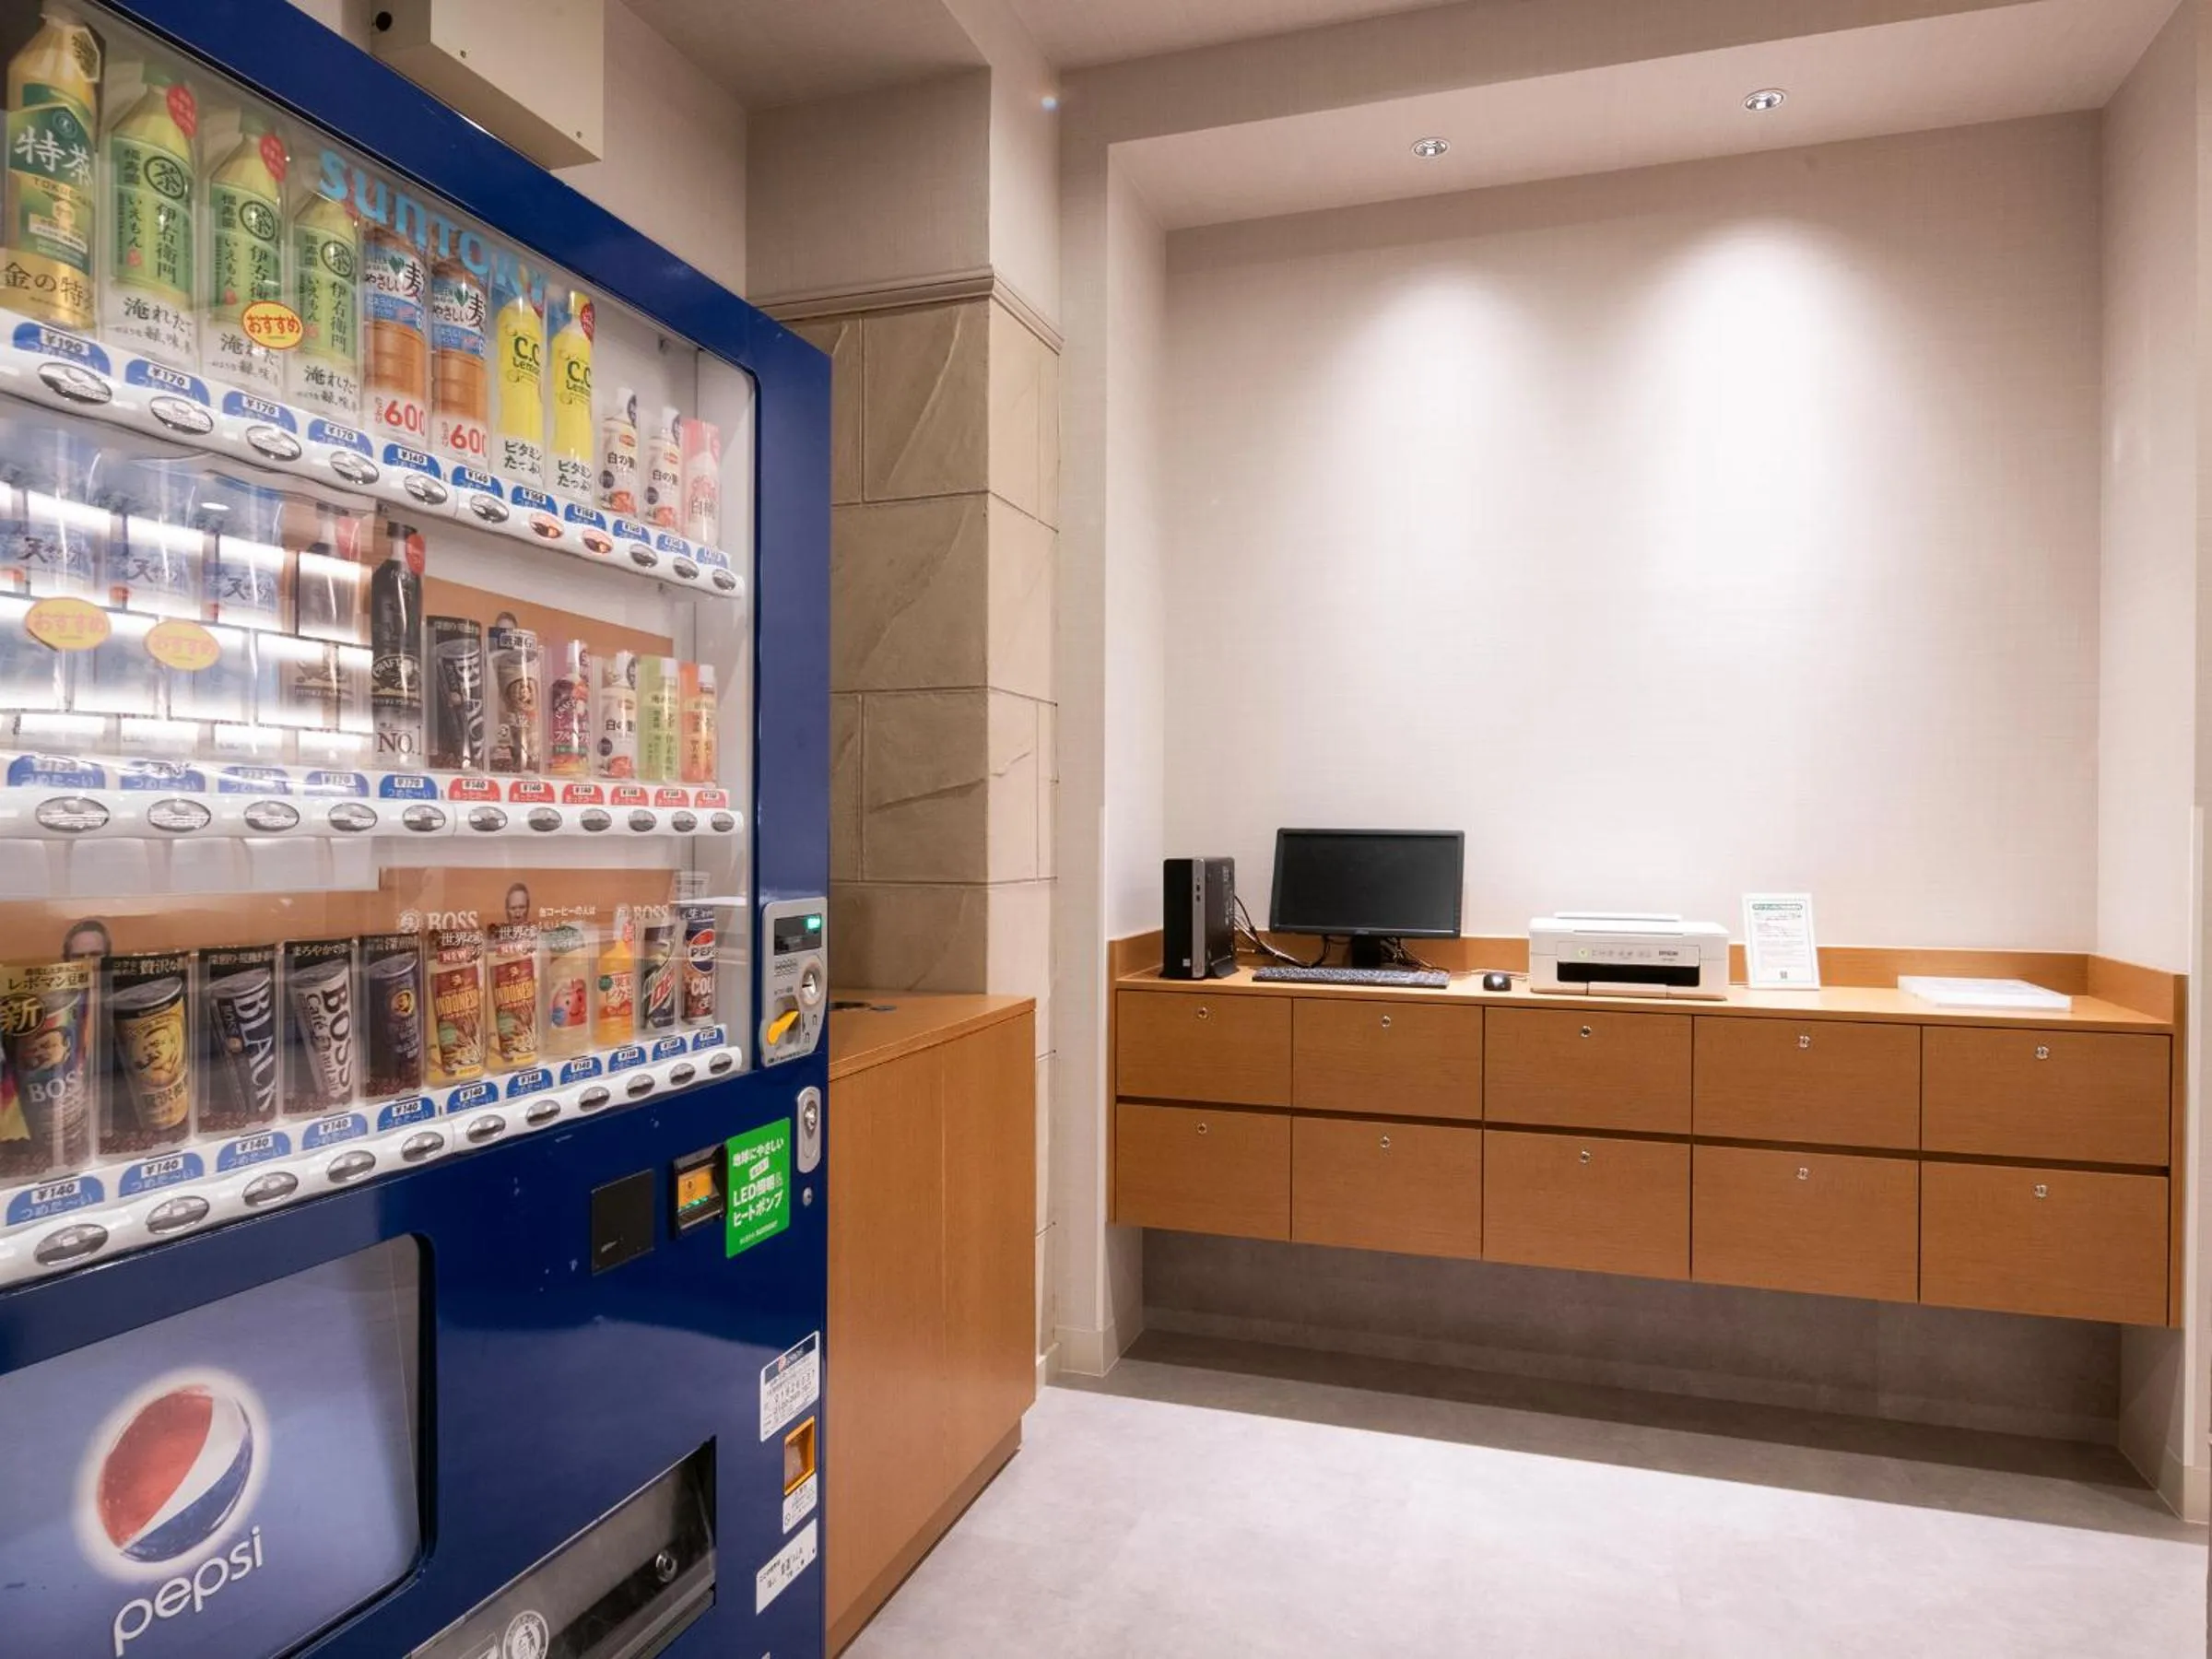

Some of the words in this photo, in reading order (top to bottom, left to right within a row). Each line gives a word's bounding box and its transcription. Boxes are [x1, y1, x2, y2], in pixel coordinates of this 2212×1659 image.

[15, 125, 91, 184] 特茶
[318, 148, 550, 303] SUNTORY
[246, 314, 301, 335] おすすめ
[233, 986, 277, 1112] BLACK
[322, 981, 352, 1088] BOSS
[28, 1070, 83, 1103] BOS
[395, 1102, 419, 1115] ¥140
[323, 1118, 349, 1133] ¥140
[240, 1137, 269, 1151] ¥140
[146, 1158, 180, 1176] ¥140
[37, 1182, 75, 1200] ¥140
[734, 1189, 783, 1228] ヒートポンプ
[113, 1525, 263, 1658] pepsi
